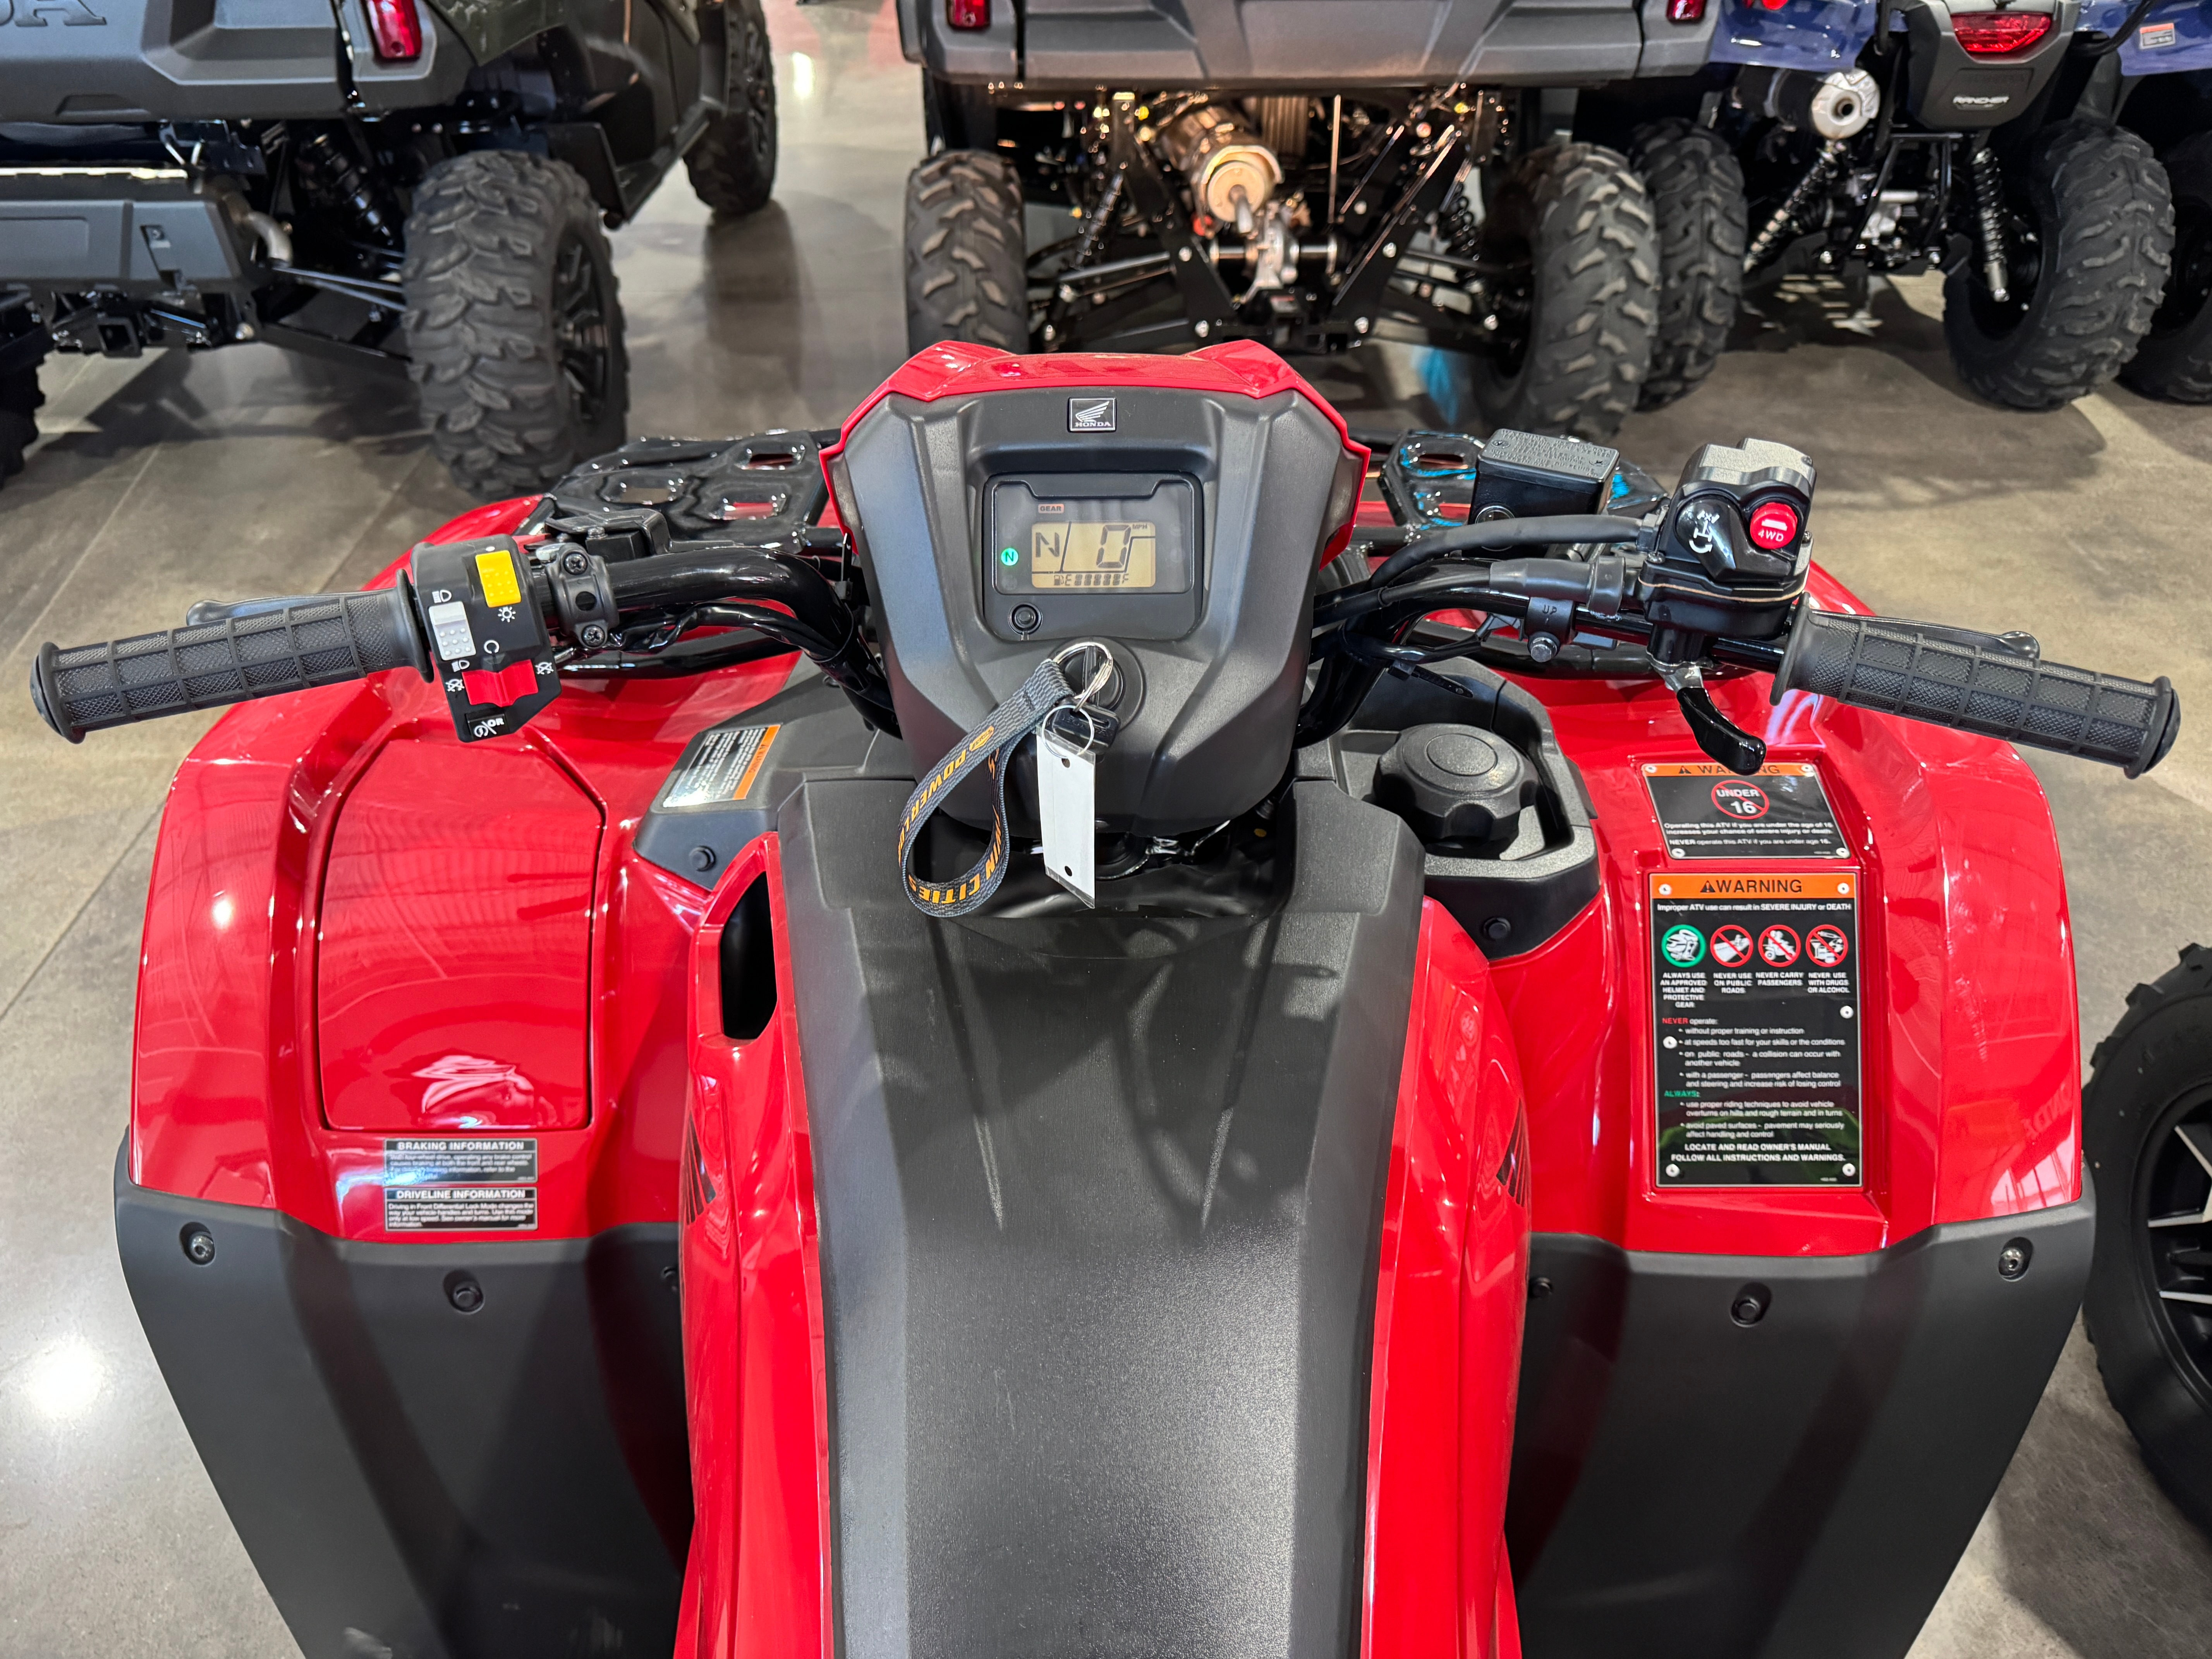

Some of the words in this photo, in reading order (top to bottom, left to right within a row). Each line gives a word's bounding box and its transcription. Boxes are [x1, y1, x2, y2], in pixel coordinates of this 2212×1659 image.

[1758, 529, 1784, 542] 4WD
[1035, 532, 1060, 558] N
[1005, 551, 1014, 562] N
[1542, 605, 1557, 615] UP
[487, 718, 505, 727] OR
[1716, 789, 1760, 797] UNDER
[1731, 800, 1757, 814] 16
[908, 873, 981, 904] CITIES
[1716, 879, 1802, 893] WARNING
[397, 1142, 447, 1151] BRAKING
[448, 1141, 524, 1150] INFORMATION
[397, 1190, 451, 1199] DRIVELINE
[452, 1190, 526, 1199] INFORMATION
